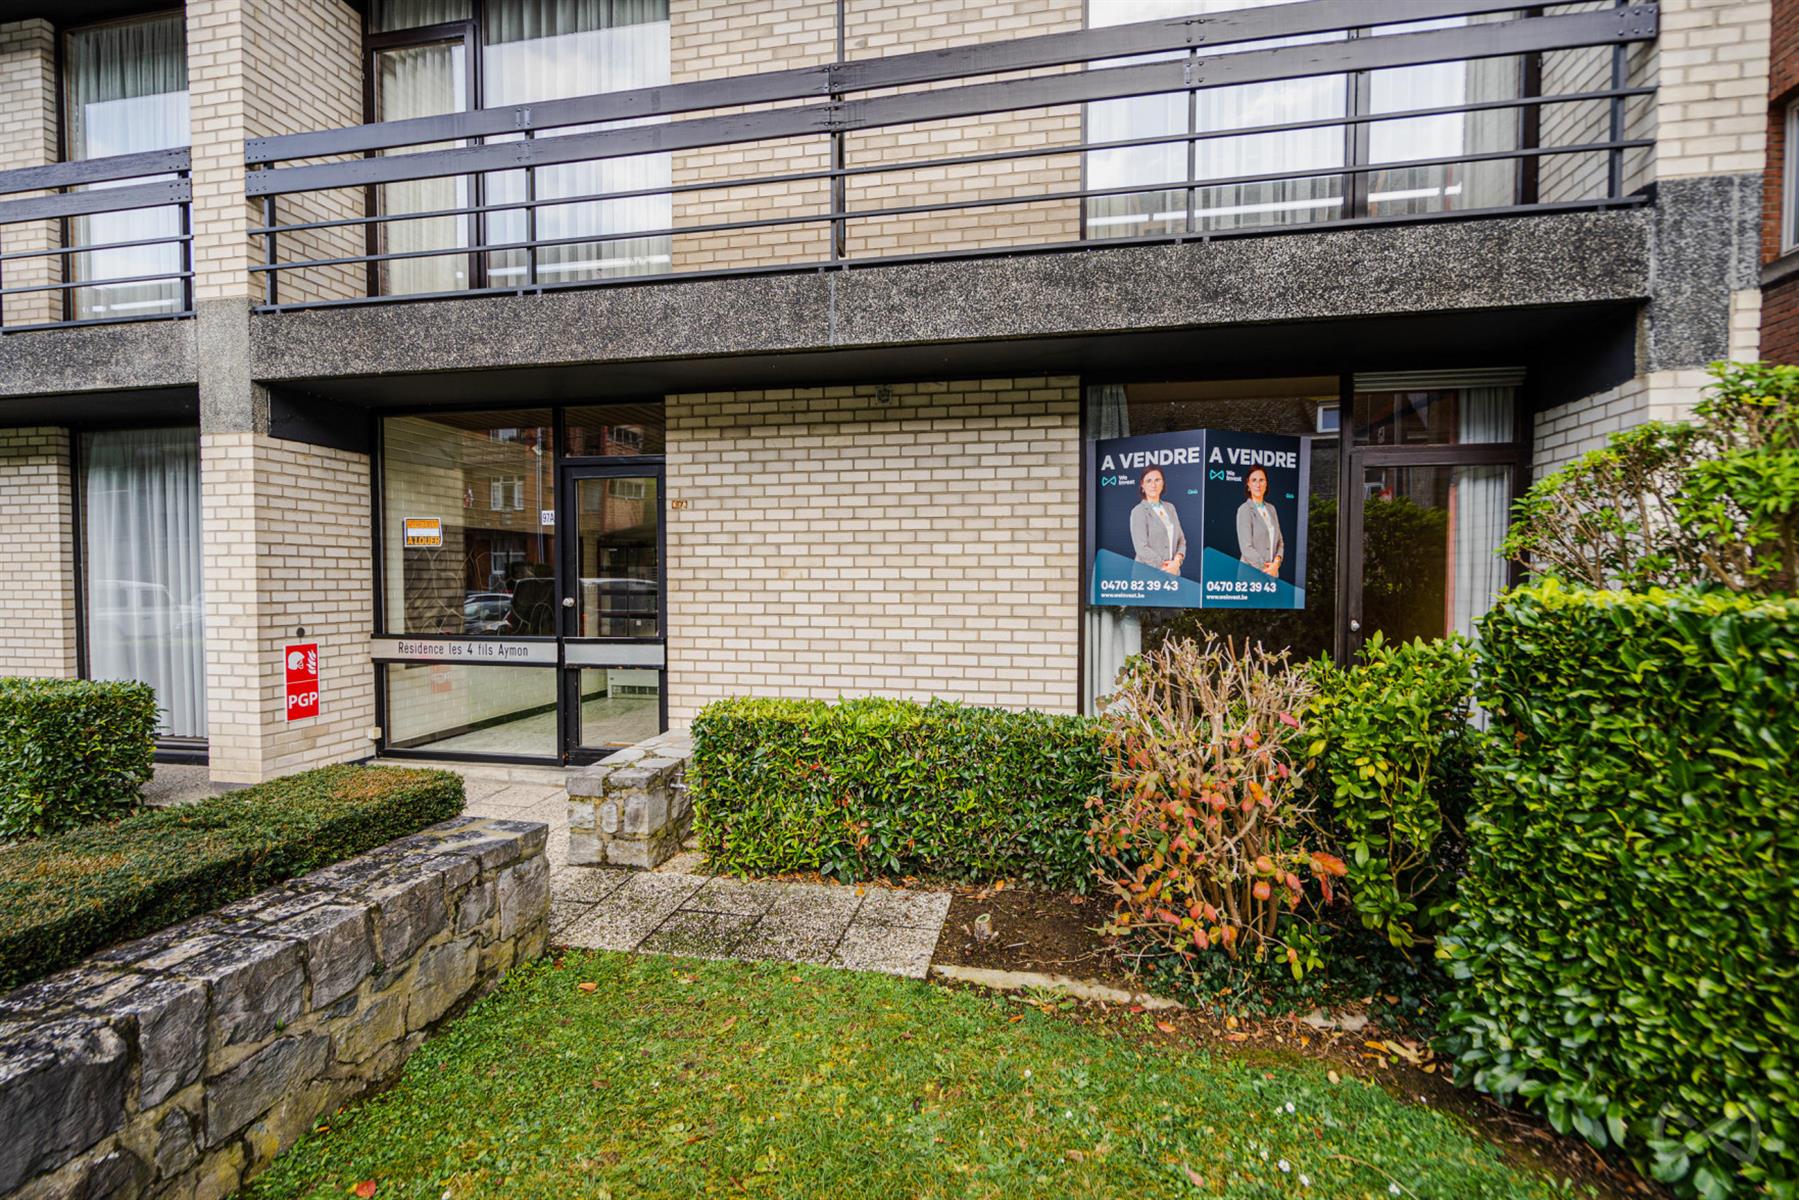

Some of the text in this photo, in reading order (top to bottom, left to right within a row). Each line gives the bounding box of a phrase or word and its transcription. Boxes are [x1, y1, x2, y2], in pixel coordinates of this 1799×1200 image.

[1101, 446, 1200, 471] A VENDRE
[1209, 446, 1297, 469] A VENDRE
[1101, 580, 1179, 591] 0470 82 39 43
[1206, 581, 1277, 593] 0470 82 39 43
[448, 643, 462, 655] les
[467, 643, 473, 655] 4
[478, 643, 493, 656] fils
[498, 643, 529, 659] Aymon
[288, 691, 318, 709] PGP
